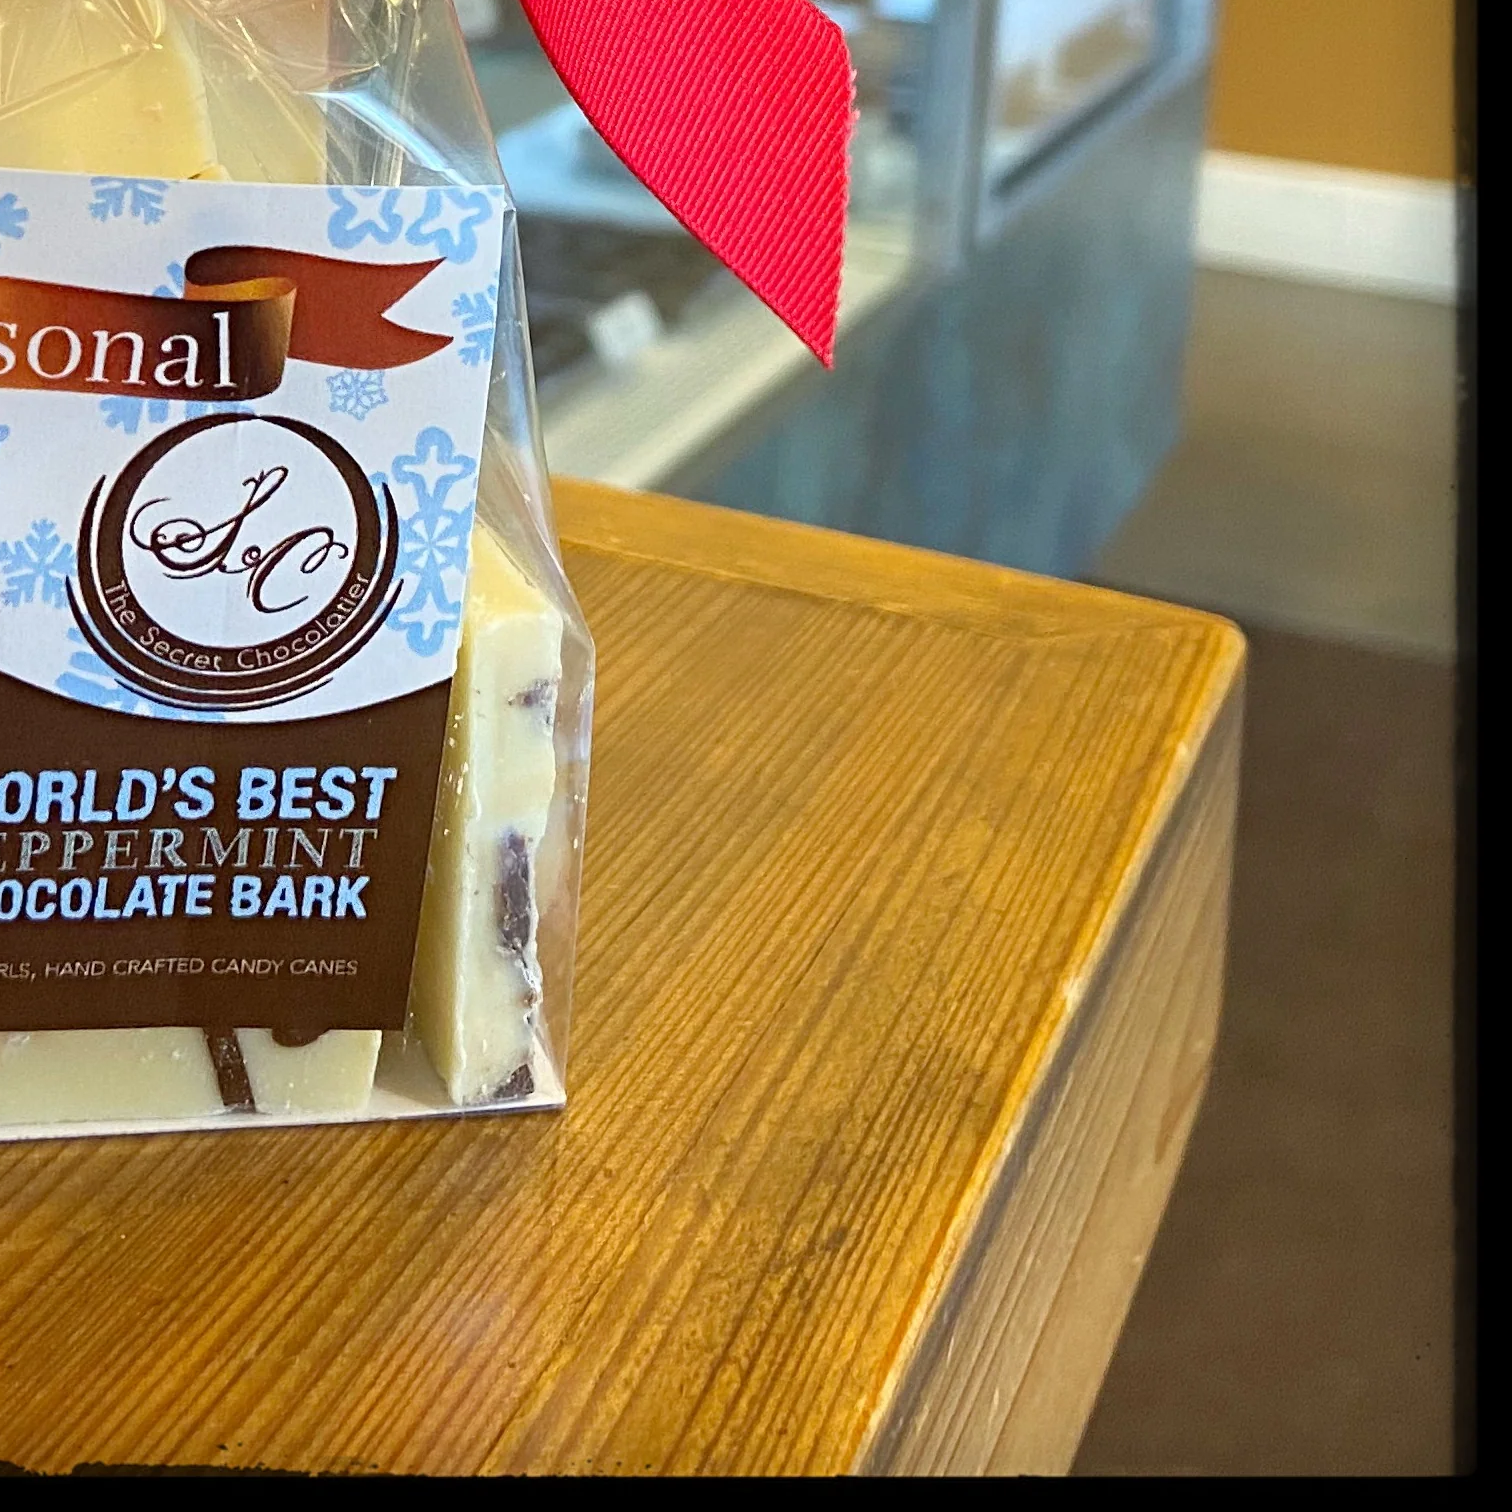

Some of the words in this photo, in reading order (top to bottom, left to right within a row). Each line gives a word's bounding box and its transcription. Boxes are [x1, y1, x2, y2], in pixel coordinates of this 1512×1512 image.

[104, 579, 137, 627] The
[139, 626, 223, 671] Secret
[237, 572, 370, 670] Chocolatier
[236, 766, 397, 823] BEST
[230, 874, 371, 920] BARK
[44, 960, 106, 978] HAND
[112, 957, 206, 976] CRAFTED
[210, 958, 285, 976] CANDY
[289, 958, 359, 977] CANES
